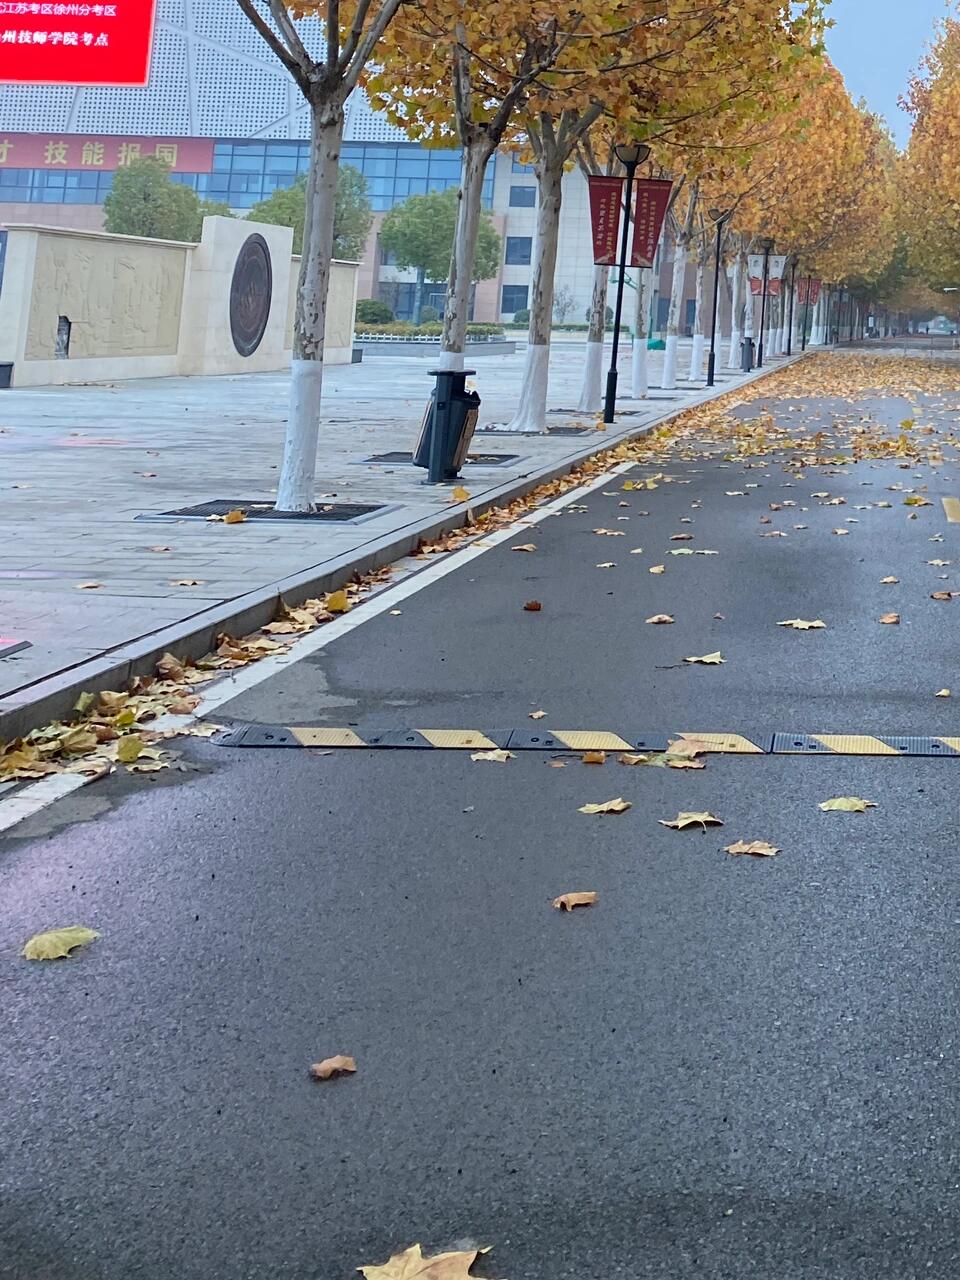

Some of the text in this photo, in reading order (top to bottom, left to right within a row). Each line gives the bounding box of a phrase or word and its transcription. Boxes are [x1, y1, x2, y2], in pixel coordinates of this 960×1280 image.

[0, 2, 117, 16] 江苏考区徐州分考区
[0, 30, 109, 46] 州技师学院考点
